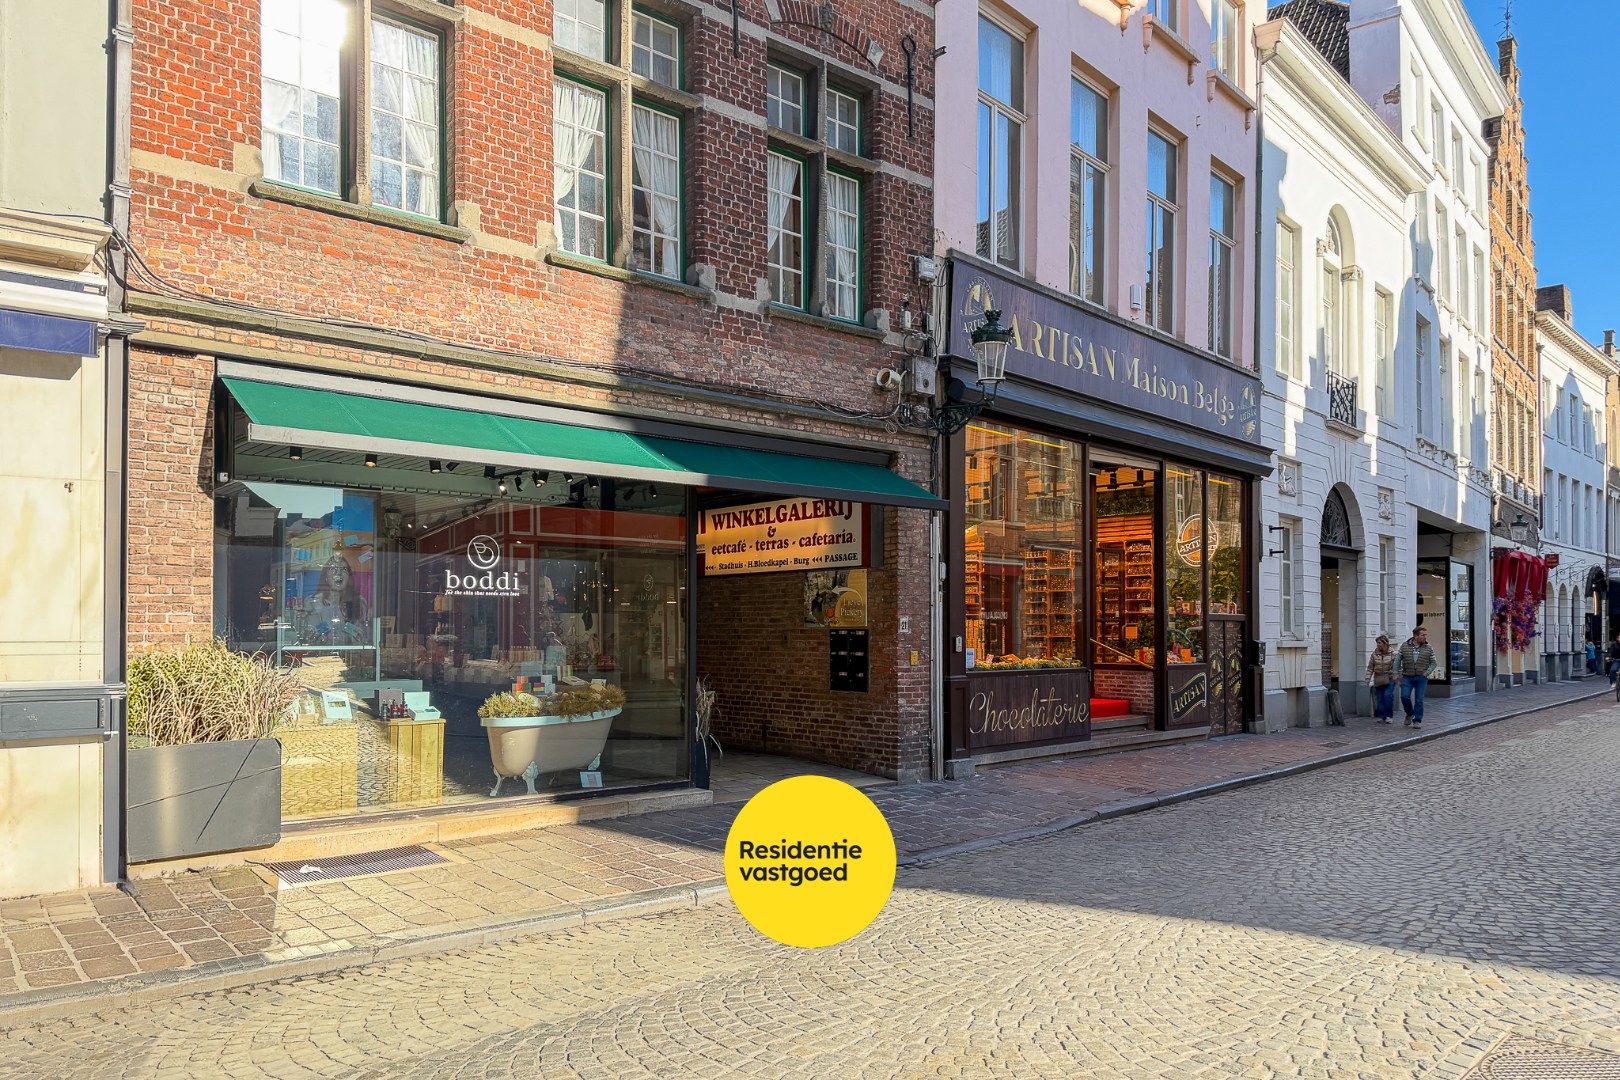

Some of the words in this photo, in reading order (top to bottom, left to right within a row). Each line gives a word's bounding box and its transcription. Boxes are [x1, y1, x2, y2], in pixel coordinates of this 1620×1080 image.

[1010, 313, 1117, 380] ARTISAN
[1121, 352, 1189, 406] Maison
[1193, 380, 1235, 426] Belge
[711, 499, 853, 531] WINKELGALERIJ
[767, 526, 776, 538] &
[711, 540, 747, 555] eetcafé
[755, 539, 789, 551] terras
[718, 561, 743, 570] Stadhuis
[793, 557, 810, 566] Burg
[824, 552, 858, 563] PASSAGE
[444, 569, 520, 590] boddi
[901, 621, 907, 630] 21
[1173, 680, 1206, 714] ARTISAN
[969, 687, 1090, 734] Chocolaterie
